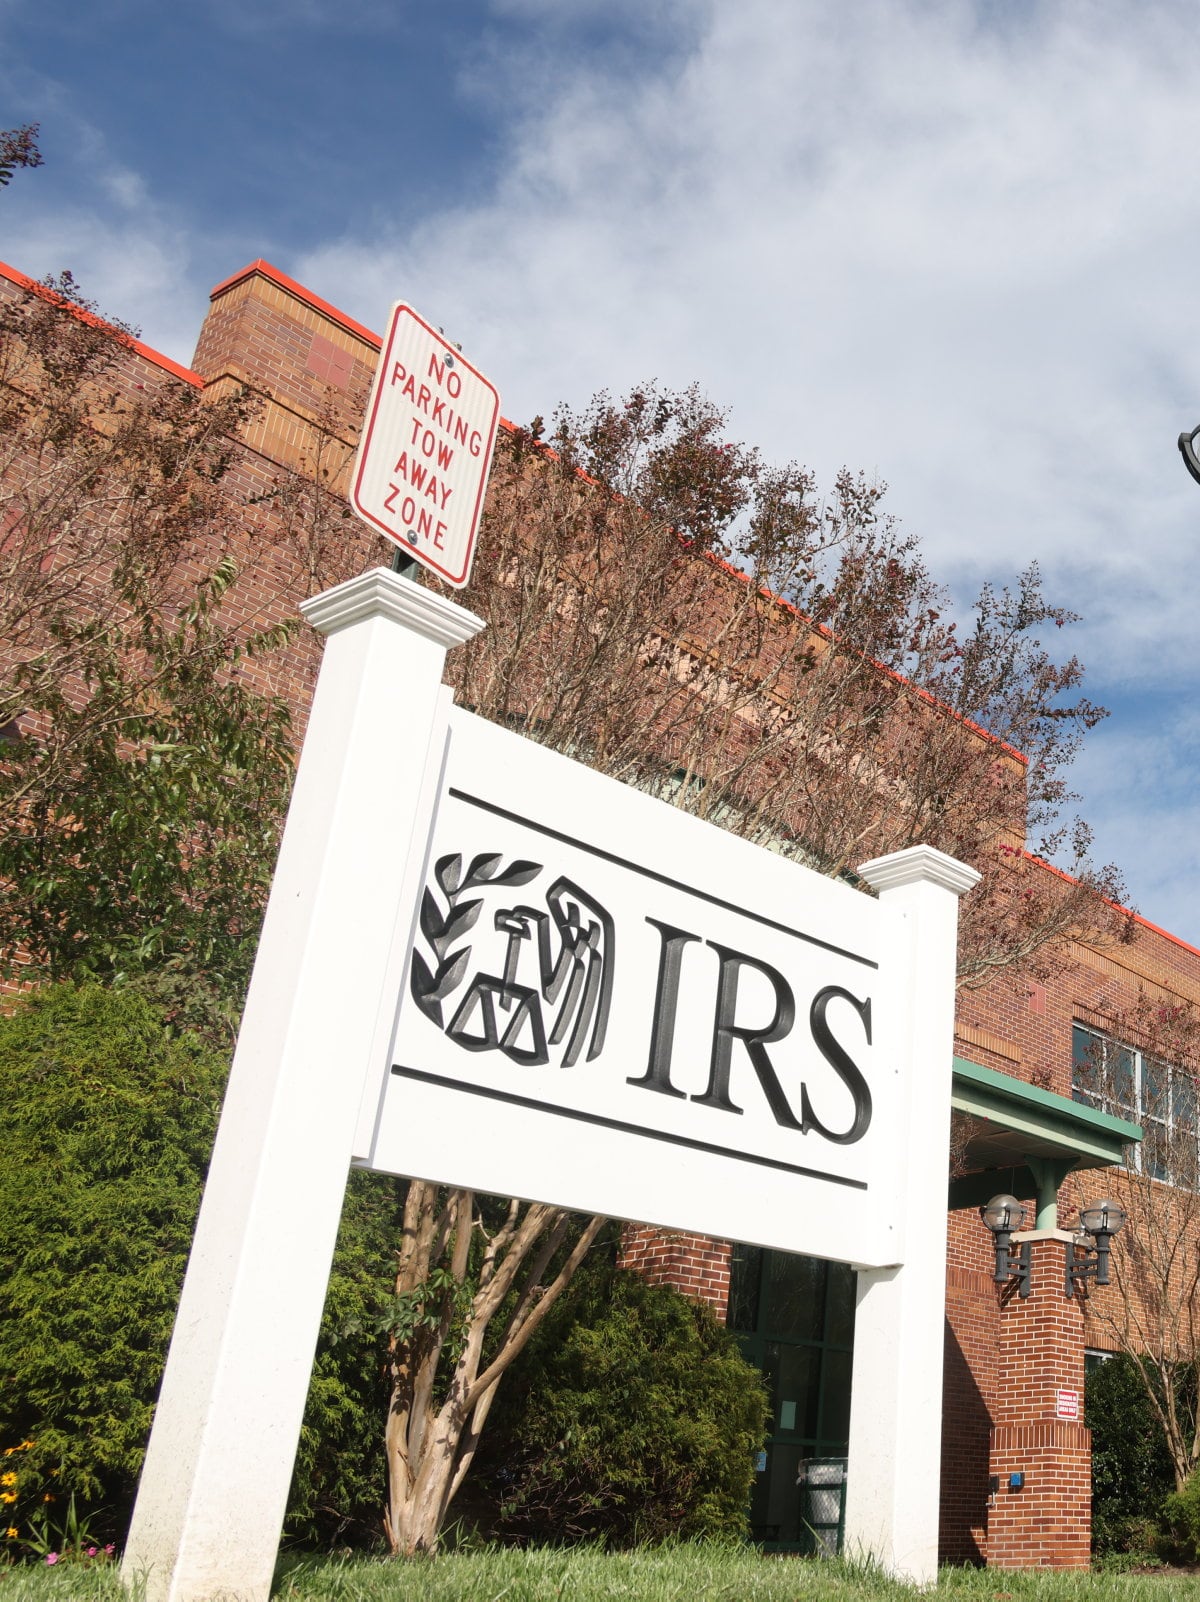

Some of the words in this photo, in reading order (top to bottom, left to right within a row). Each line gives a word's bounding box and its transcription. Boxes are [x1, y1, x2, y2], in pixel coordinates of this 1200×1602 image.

[428, 352, 461, 399] NO
[391, 361, 482, 457] PARKING
[411, 416, 454, 472] TOW
[393, 451, 453, 510] AWAY
[383, 482, 448, 551] ZONE
[626, 915, 873, 1146] IRS
